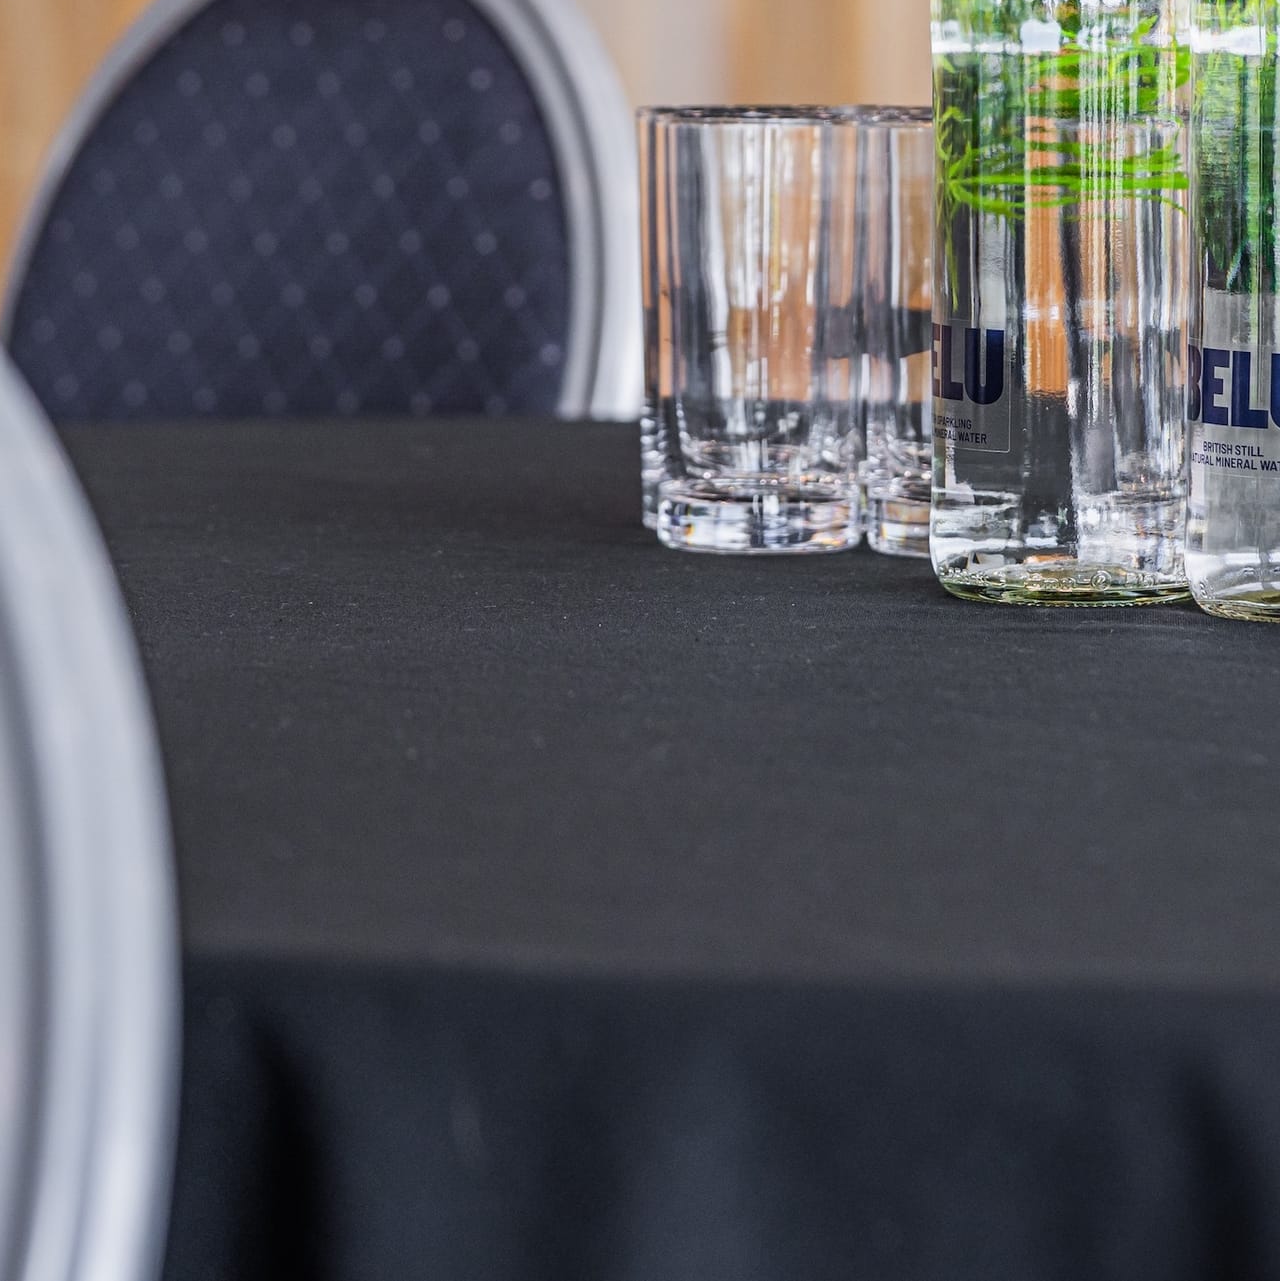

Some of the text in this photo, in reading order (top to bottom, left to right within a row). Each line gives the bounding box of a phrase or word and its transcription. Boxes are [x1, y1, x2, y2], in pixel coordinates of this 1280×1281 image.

[931, 323, 1005, 405] ELU
[956, 431, 987, 445] WATER
[1203, 440, 1264, 457] BRITISH STILL
[1191, 452, 1214, 466] ATURAL
[1215, 456, 1257, 471] MINERAL
